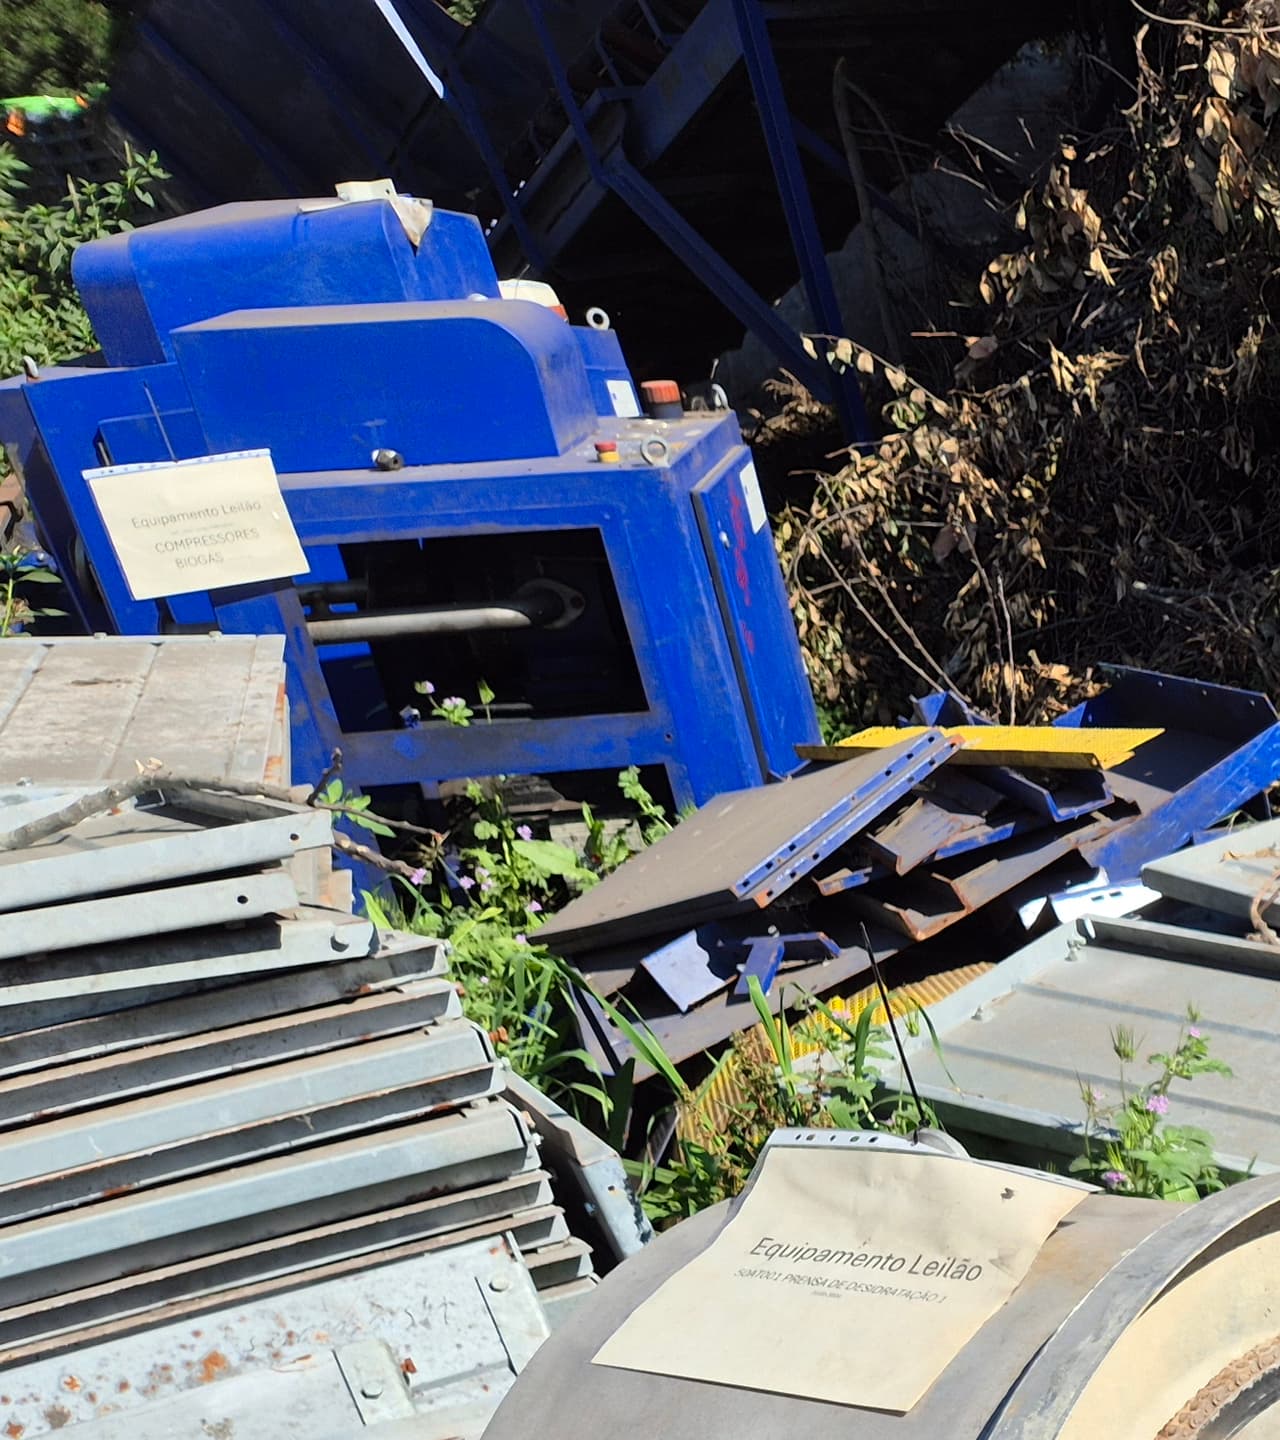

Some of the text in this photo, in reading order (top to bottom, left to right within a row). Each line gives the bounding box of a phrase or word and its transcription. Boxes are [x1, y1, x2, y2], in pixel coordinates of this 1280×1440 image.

[131, 507, 220, 529] Equipamento
[221, 500, 262, 515] Leilão
[155, 527, 260, 553] COMPRESSORES
[749, 1237, 983, 1281] Equipamento Leilão
[782, 1273, 828, 1287] PRENSA
[827, 1279, 848, 1290] DE
[845, 1281, 938, 1303] DESIDRATAÇÃO
